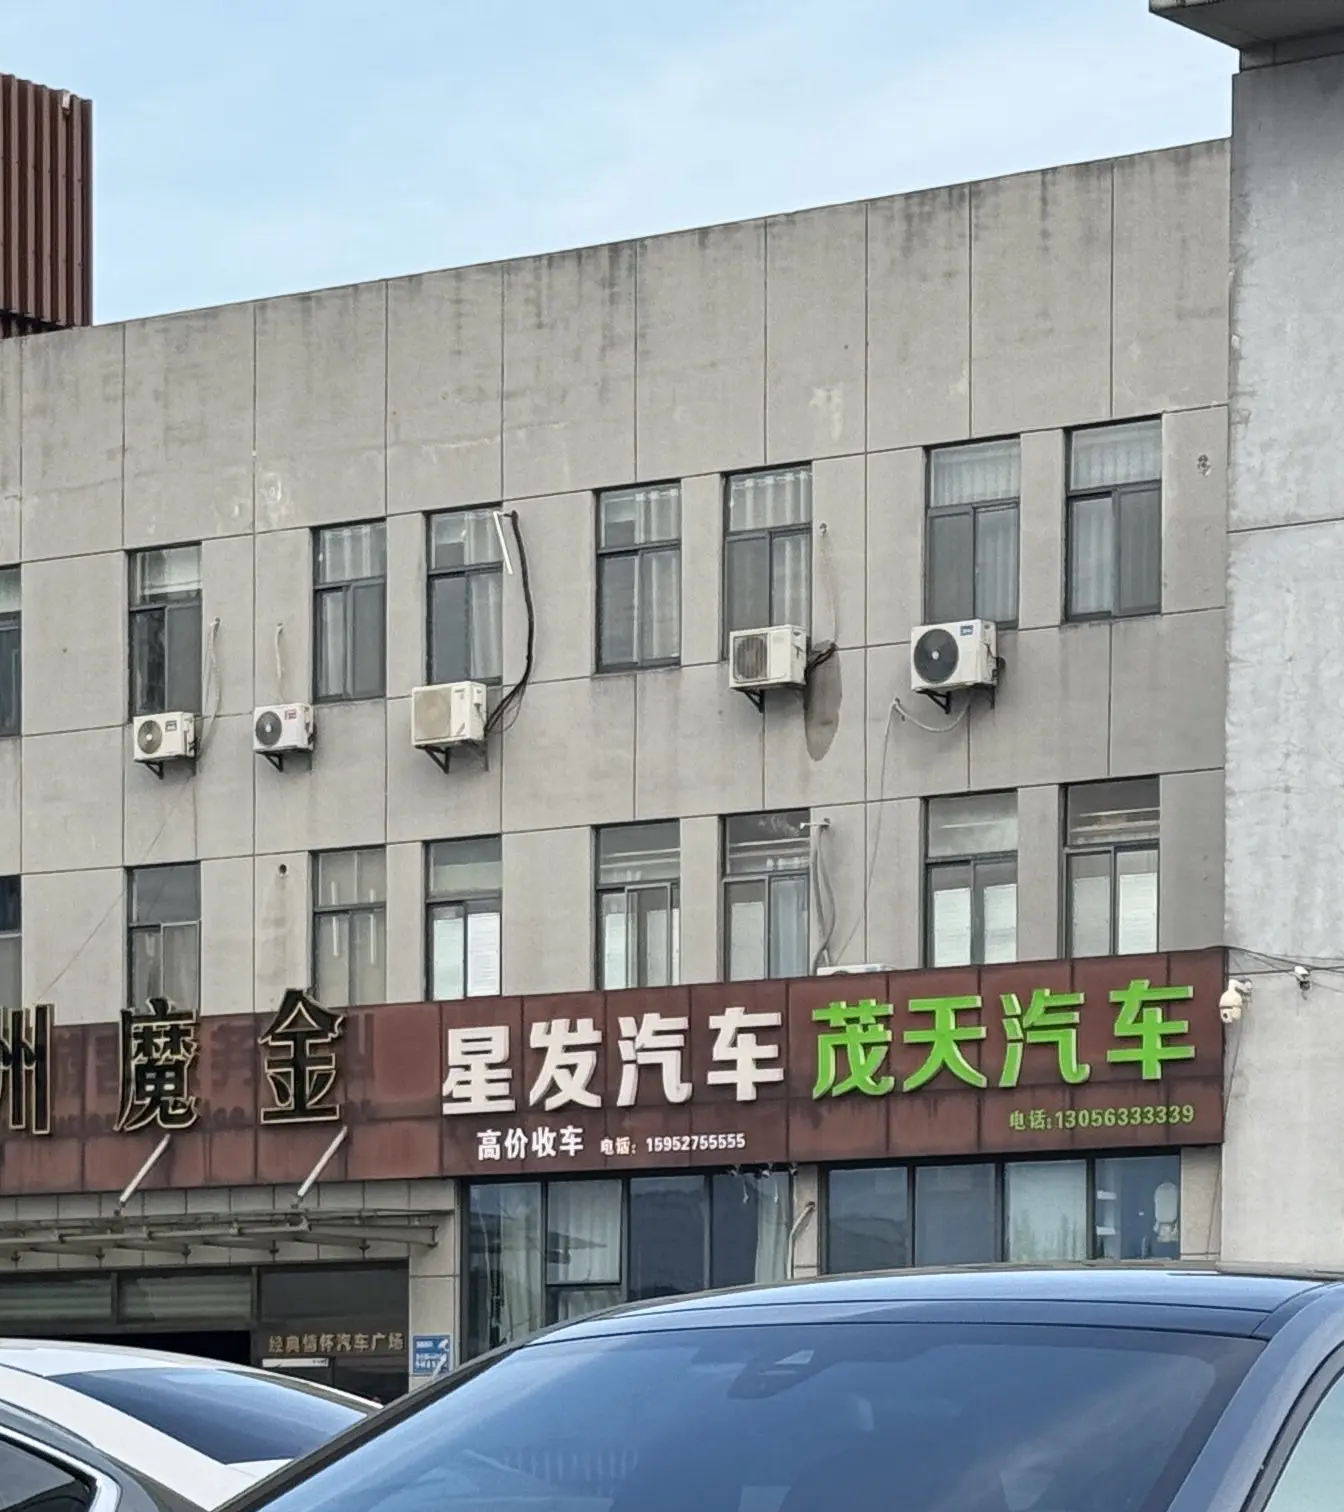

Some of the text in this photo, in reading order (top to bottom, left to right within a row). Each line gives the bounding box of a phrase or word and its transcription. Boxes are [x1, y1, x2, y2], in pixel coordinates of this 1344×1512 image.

[442, 1006, 786, 1116] 星发汽车
[811, 978, 1197, 1100] 茂天汽车
[476, 1125, 584, 1160] 高价收车
[646, 1132, 746, 1152] 15952755555
